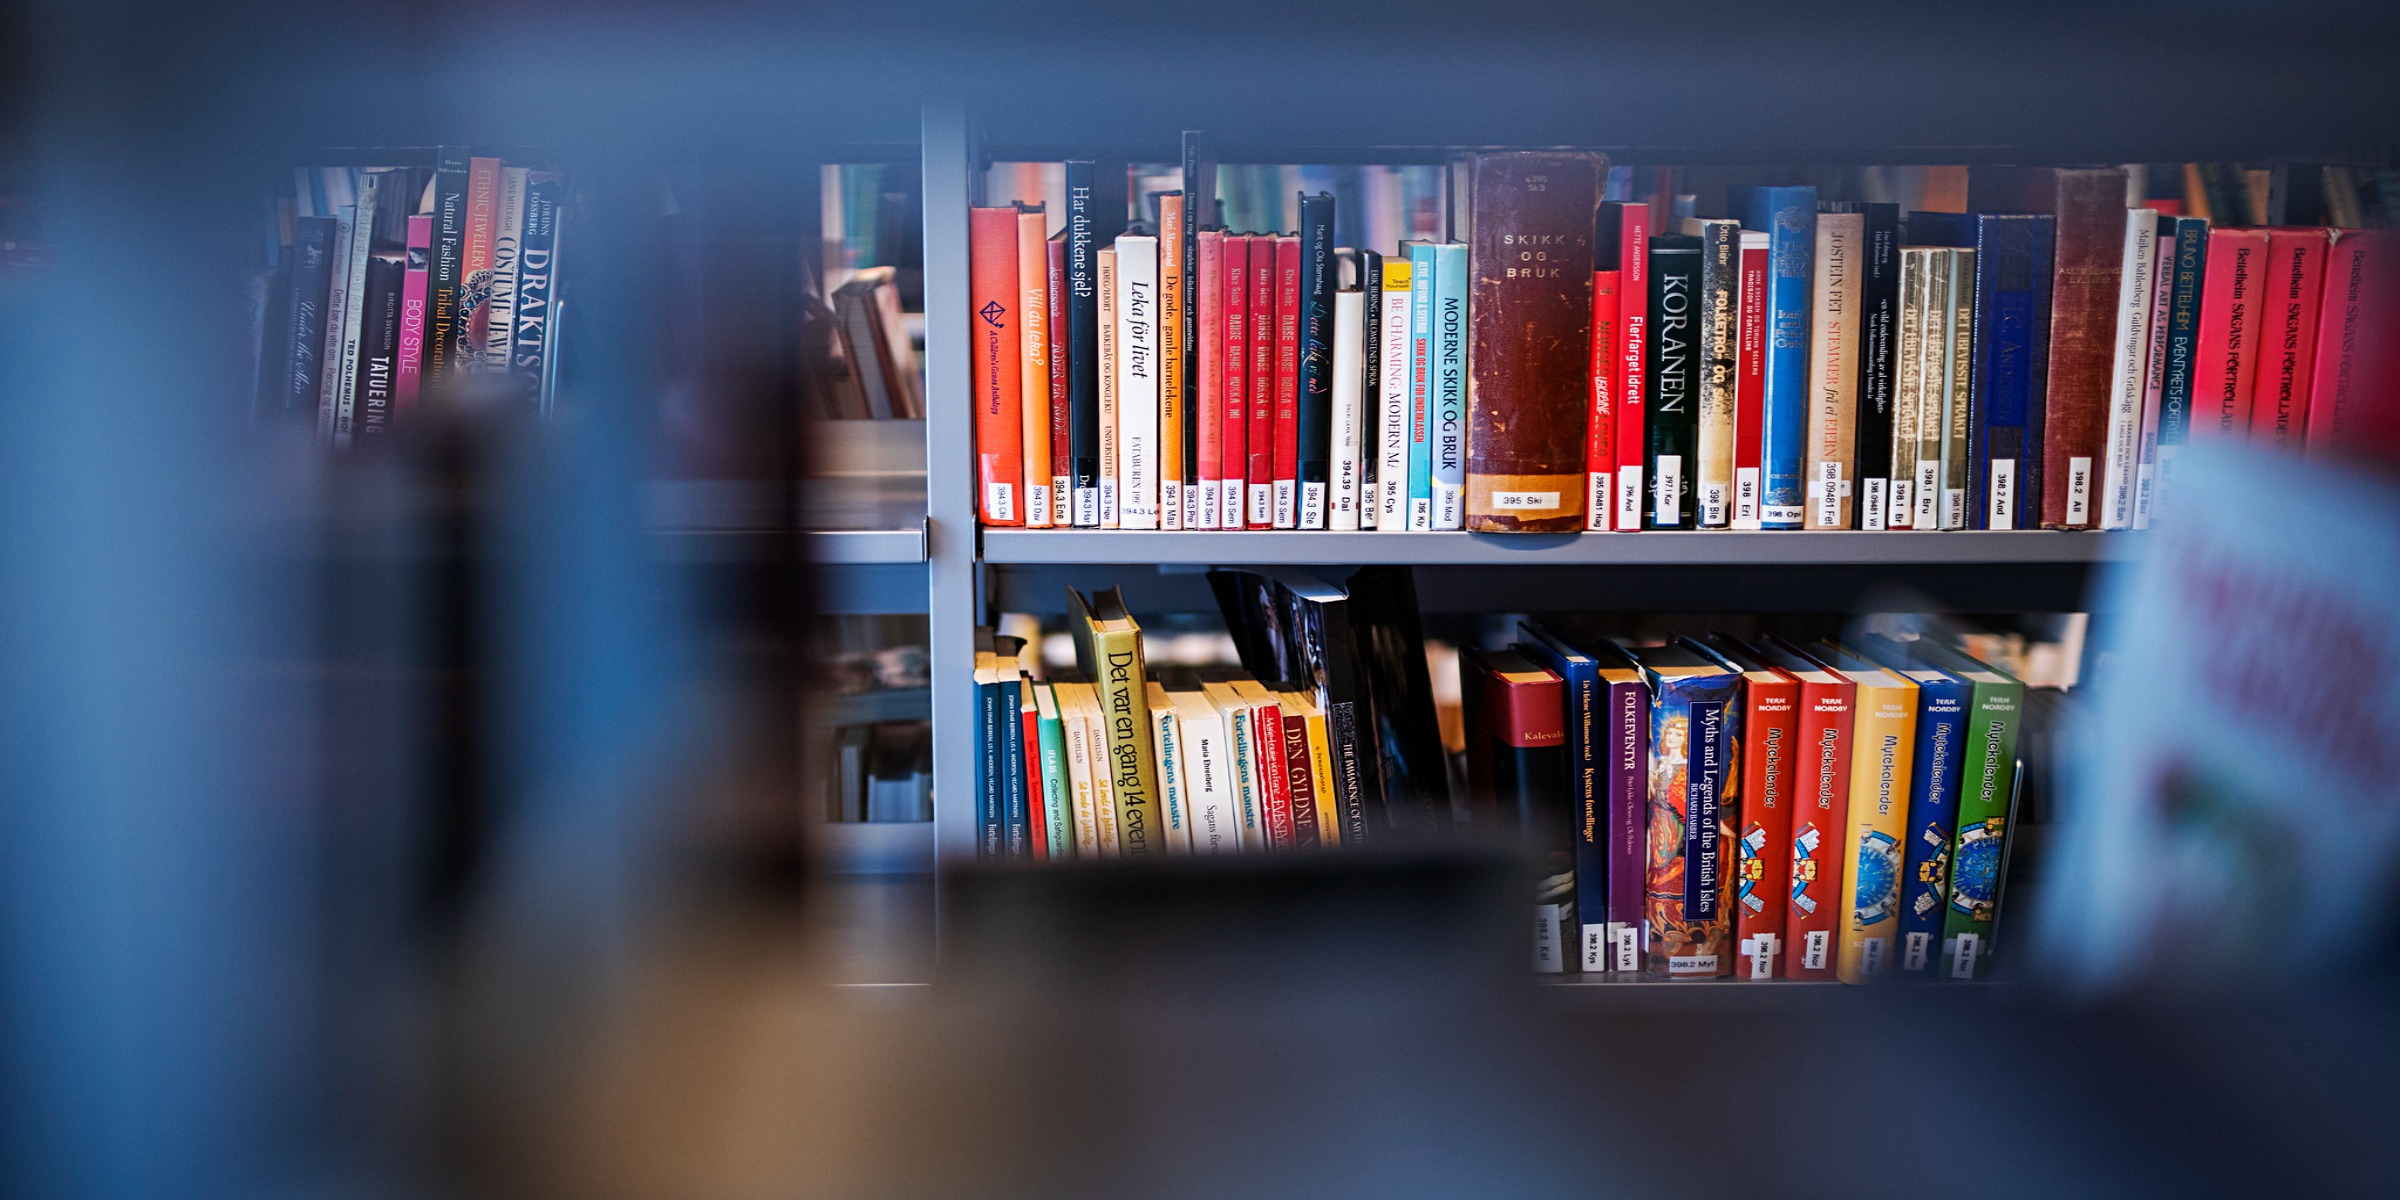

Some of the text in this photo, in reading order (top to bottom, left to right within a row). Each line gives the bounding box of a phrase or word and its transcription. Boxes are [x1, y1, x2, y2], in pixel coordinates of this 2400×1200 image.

[442, 192, 460, 234] Natural
[474, 169, 491, 212] ETHNIC
[528, 191, 540, 235] FOSSBERG
[540, 199, 552, 236] JORUNN
[1071, 186, 1091, 297] Har dukkene sjel?
[1503, 234, 1566, 245] SKIKK
[438, 236, 457, 281] Fashion
[1520, 251, 1547, 262] OG
[1829, 232, 1844, 288] JOSTEIN
[2136, 229, 2150, 260] Majken
[490, 236, 517, 315] COSTUME
[1506, 267, 1560, 278] BRUK
[2130, 262, 2146, 308] Bahlenberg
[2289, 247, 2306, 299] Bettelheim
[436, 286, 454, 319] Tribal
[1028, 288, 1044, 366] Vill du leka?
[1369, 269, 1379, 387] ERIK BERING BLOMSTENES SPRÅK
[1828, 290, 1842, 314] FET
[1957, 308, 1970, 329] DET
[2149, 255, 2173, 391] VERBAL ART AS PERFORMANCE
[2169, 229, 2198, 395] BRUNO BETTELHEIM EVENTYRETS
[2284, 303, 2301, 350] SAGANS
[401, 299, 423, 375] BODY STYLE
[1103, 324, 1113, 362] BARKEBÅT
[1126, 281, 1149, 379] Leka för livet
[1162, 275, 1178, 418] De gode, gamle barnelekene
[1302, 300, 1328, 394] Dette leika vi med
[1659, 273, 1689, 414] KORANEN
[1826, 321, 1841, 385] STEMMER
[2126, 311, 2142, 358] Guldvingar
[343, 339, 356, 406] TED POLHEMUS
[1103, 362, 1112, 373] OG
[1387, 297, 1403, 449] BE CHARMING: MODERN
[1442, 297, 1458, 470] MODERNE SKIKK OG BRUK
[1625, 316, 1643, 405] Flerfarget idrett
[1714, 365, 1726, 383] OG
[1955, 331, 1970, 389] UBEVISSTE
[2127, 358, 2138, 374] och
[1103, 374, 1113, 414] KONGLEKU
[1414, 338, 1427, 443] SKIKK OG BRUK FOR UNDERKLASSEN
[1825, 406, 1839, 416] ei
[1131, 436, 1142, 489] FATABUREN
[1341, 460, 1352, 512] 394.39 Dal
[1056, 503, 1066, 519] Ene
[1166, 509, 1177, 526] Mau
[1384, 481, 1396, 514] 395 Cys
[1503, 496, 1542, 505] 395 Ski
[1593, 475, 1604, 528] 395.09481 Hag
[1742, 481, 1752, 517] 398 Eri
[1824, 463, 1836, 525] 398.09481 Fet
[1996, 474, 2007, 515] 398.2 And
[1108, 651, 1146, 807] Det var en gang 14
[1624, 691, 1636, 770] FOLKEEVENTYR
[1758, 704, 1792, 712] NORDBY
[1813, 704, 1848, 713] NORDBY
[1928, 705, 1961, 713] NORDBY
[1161, 715, 1182, 830] Fortellingens mønstre
[1201, 739, 1218, 833] Maria Ehrenberg Sagans
[1235, 714, 1256, 829] Fortellingens mønstre
[1286, 728, 1312, 830] DEN GYLDNE
[1342, 743, 1360, 821] THE IMMANENCE OF
[1763, 727, 1782, 809] Mytekalender
[1818, 728, 1839, 810] Mytekalender
[1878, 735, 1898, 816] Mytekalender
[1928, 722, 1951, 804] Mytekalender
[1981, 720, 2005, 802] Mytekalender
[1049, 778, 1061, 821] Collecting and
[1583, 768, 1596, 843] Kystens fortellinger
[1688, 783, 1699, 841] RICHARD BARBER
[1699, 708, 1720, 912] Myths and Legends of the British Isles
[1587, 933, 1597, 964] 398.2 Kys
